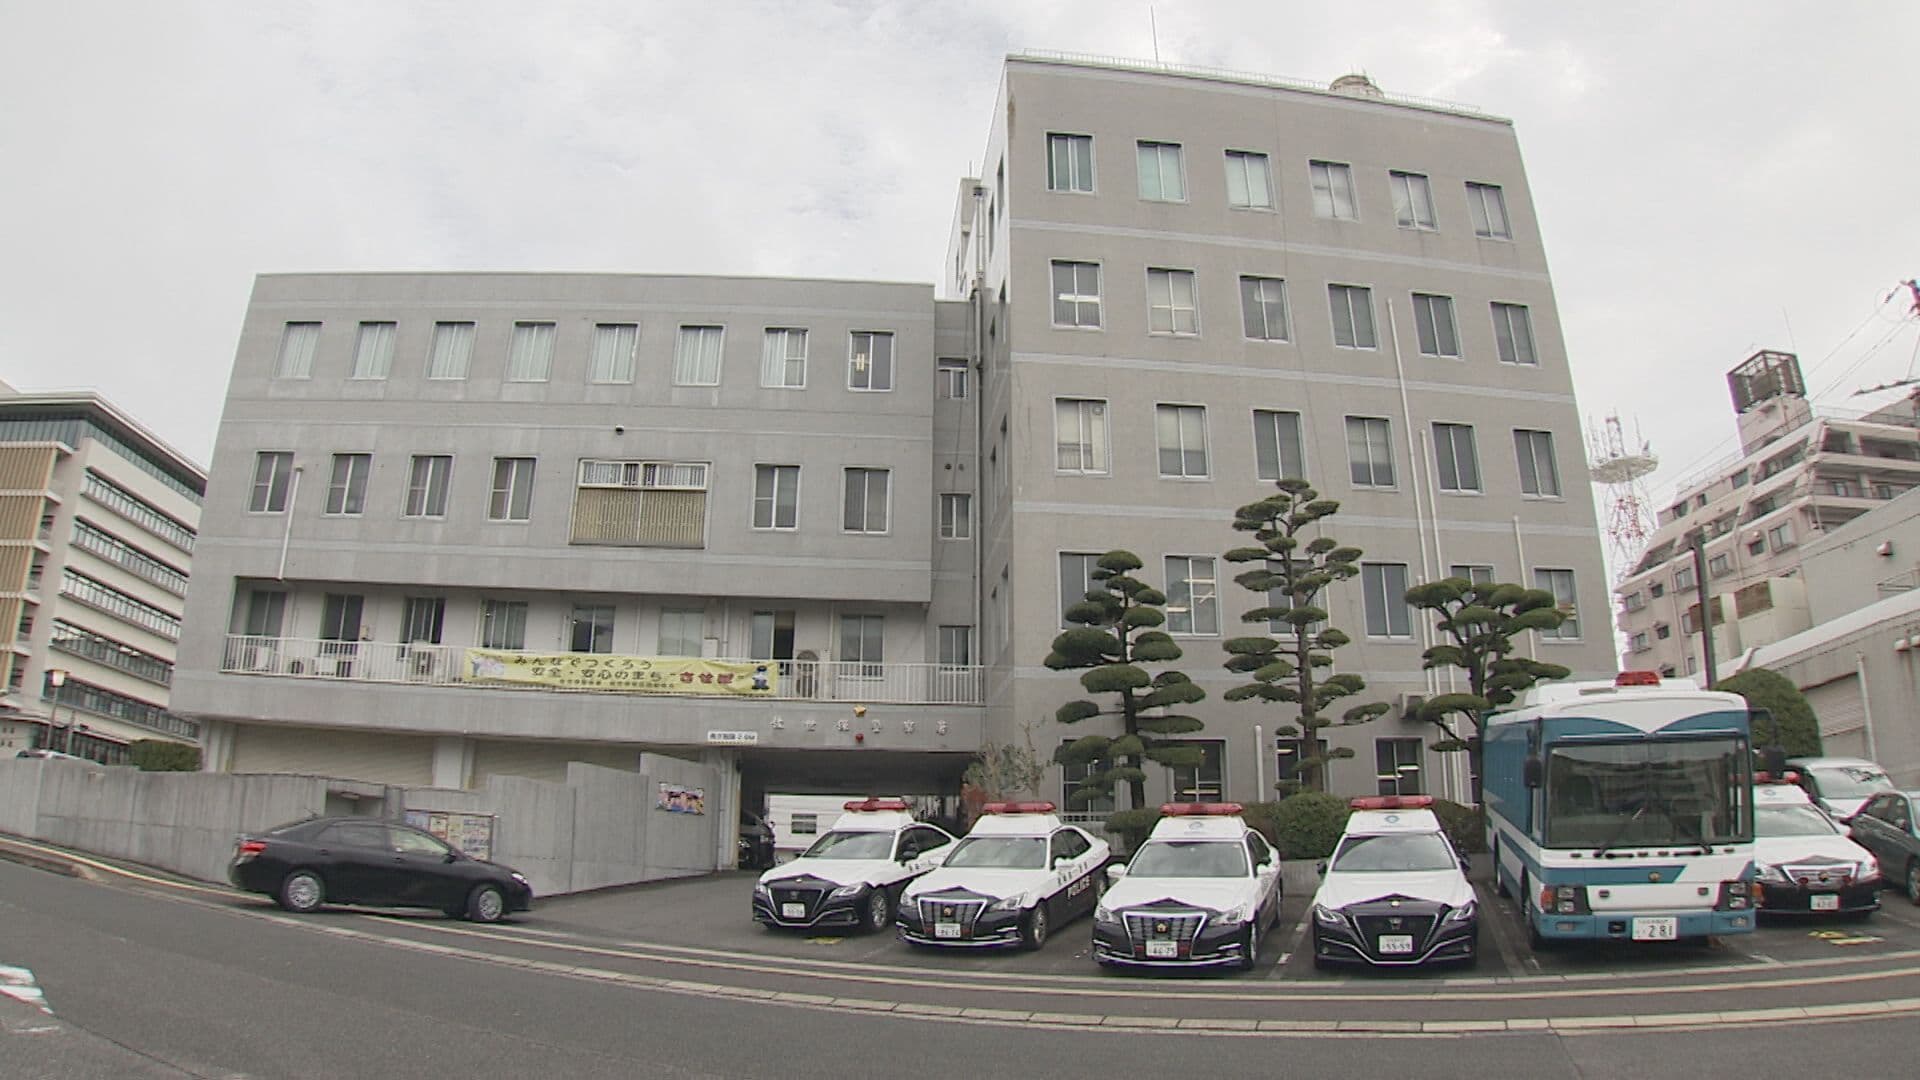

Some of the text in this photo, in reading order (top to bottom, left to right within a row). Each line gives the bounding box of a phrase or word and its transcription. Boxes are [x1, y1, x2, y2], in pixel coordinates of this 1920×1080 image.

[513, 655, 653, 670] みんなでつくろう
